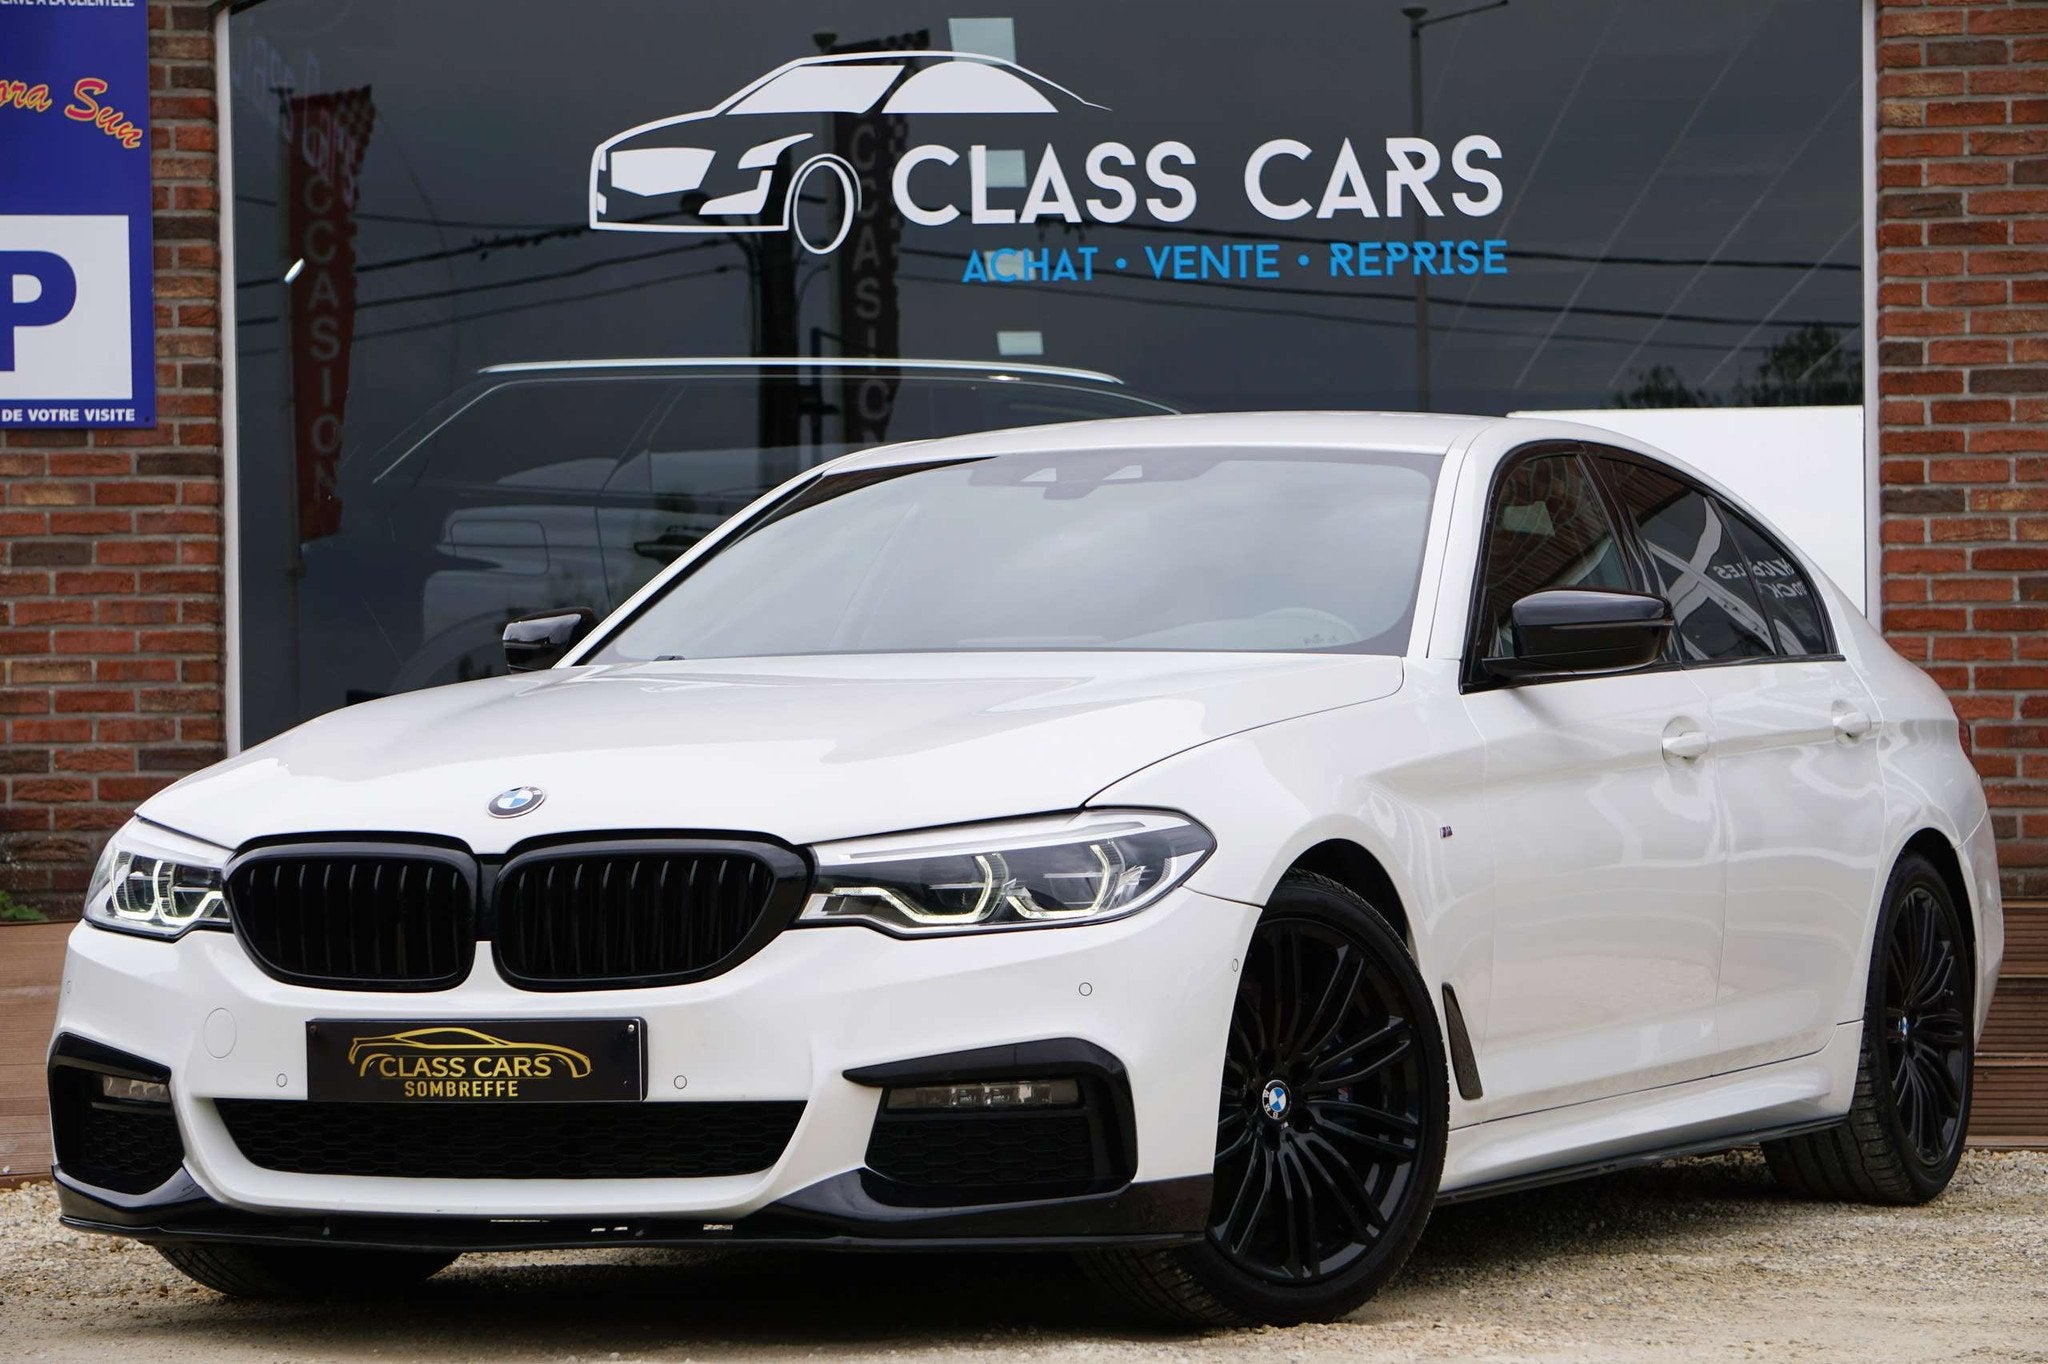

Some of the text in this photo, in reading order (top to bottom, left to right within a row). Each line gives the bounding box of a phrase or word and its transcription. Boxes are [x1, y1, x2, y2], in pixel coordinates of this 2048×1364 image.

[64, 78, 143, 149] Sun
[892, 135, 1503, 226] CLASS CARS
[962, 239, 1508, 283] ACHAT VENTE REPRISE
[2, 408, 136, 422] DE VOTRE VISITE
[379, 1056, 551, 1077] CLASS CARS
[404, 1081, 519, 1097] SOMBREFFE
